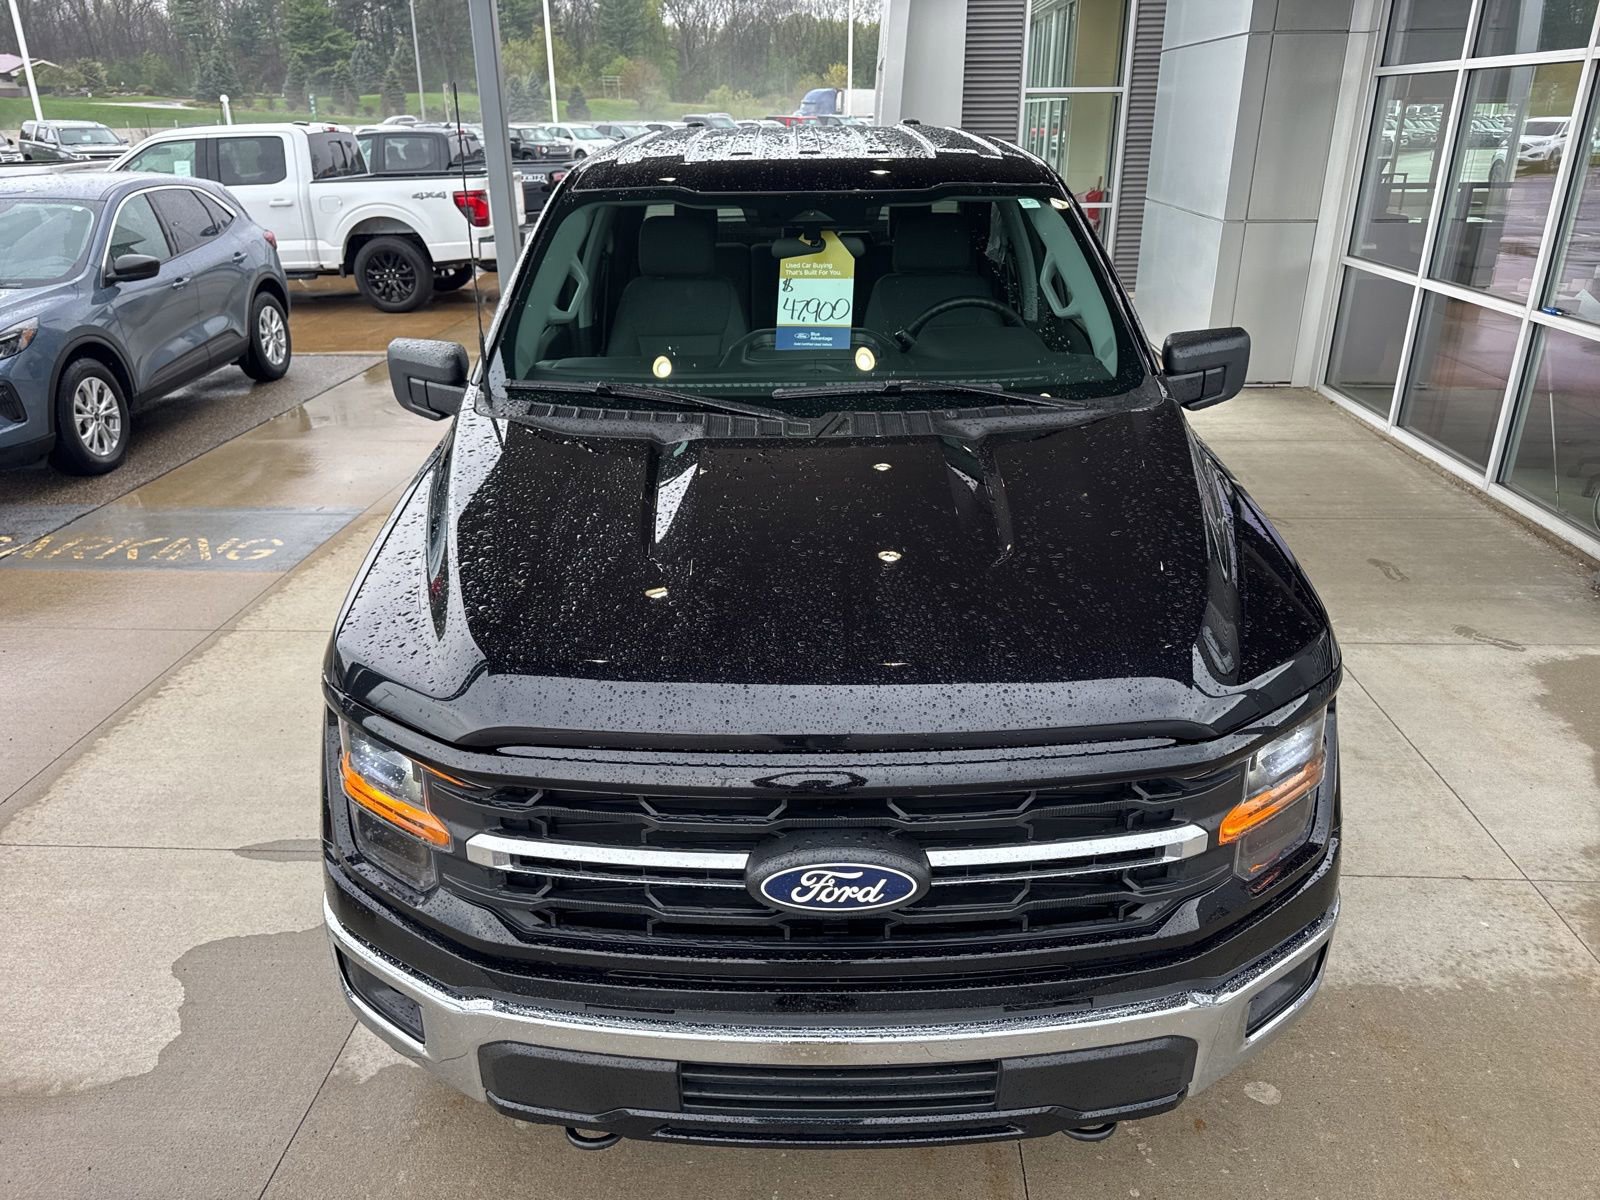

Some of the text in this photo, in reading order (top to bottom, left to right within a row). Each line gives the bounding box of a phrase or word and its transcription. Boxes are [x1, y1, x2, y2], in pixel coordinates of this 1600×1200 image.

[812, 262, 833, 271] Buying
[783, 298, 851, 323] 47,900
[791, 870, 887, 903] Ford
